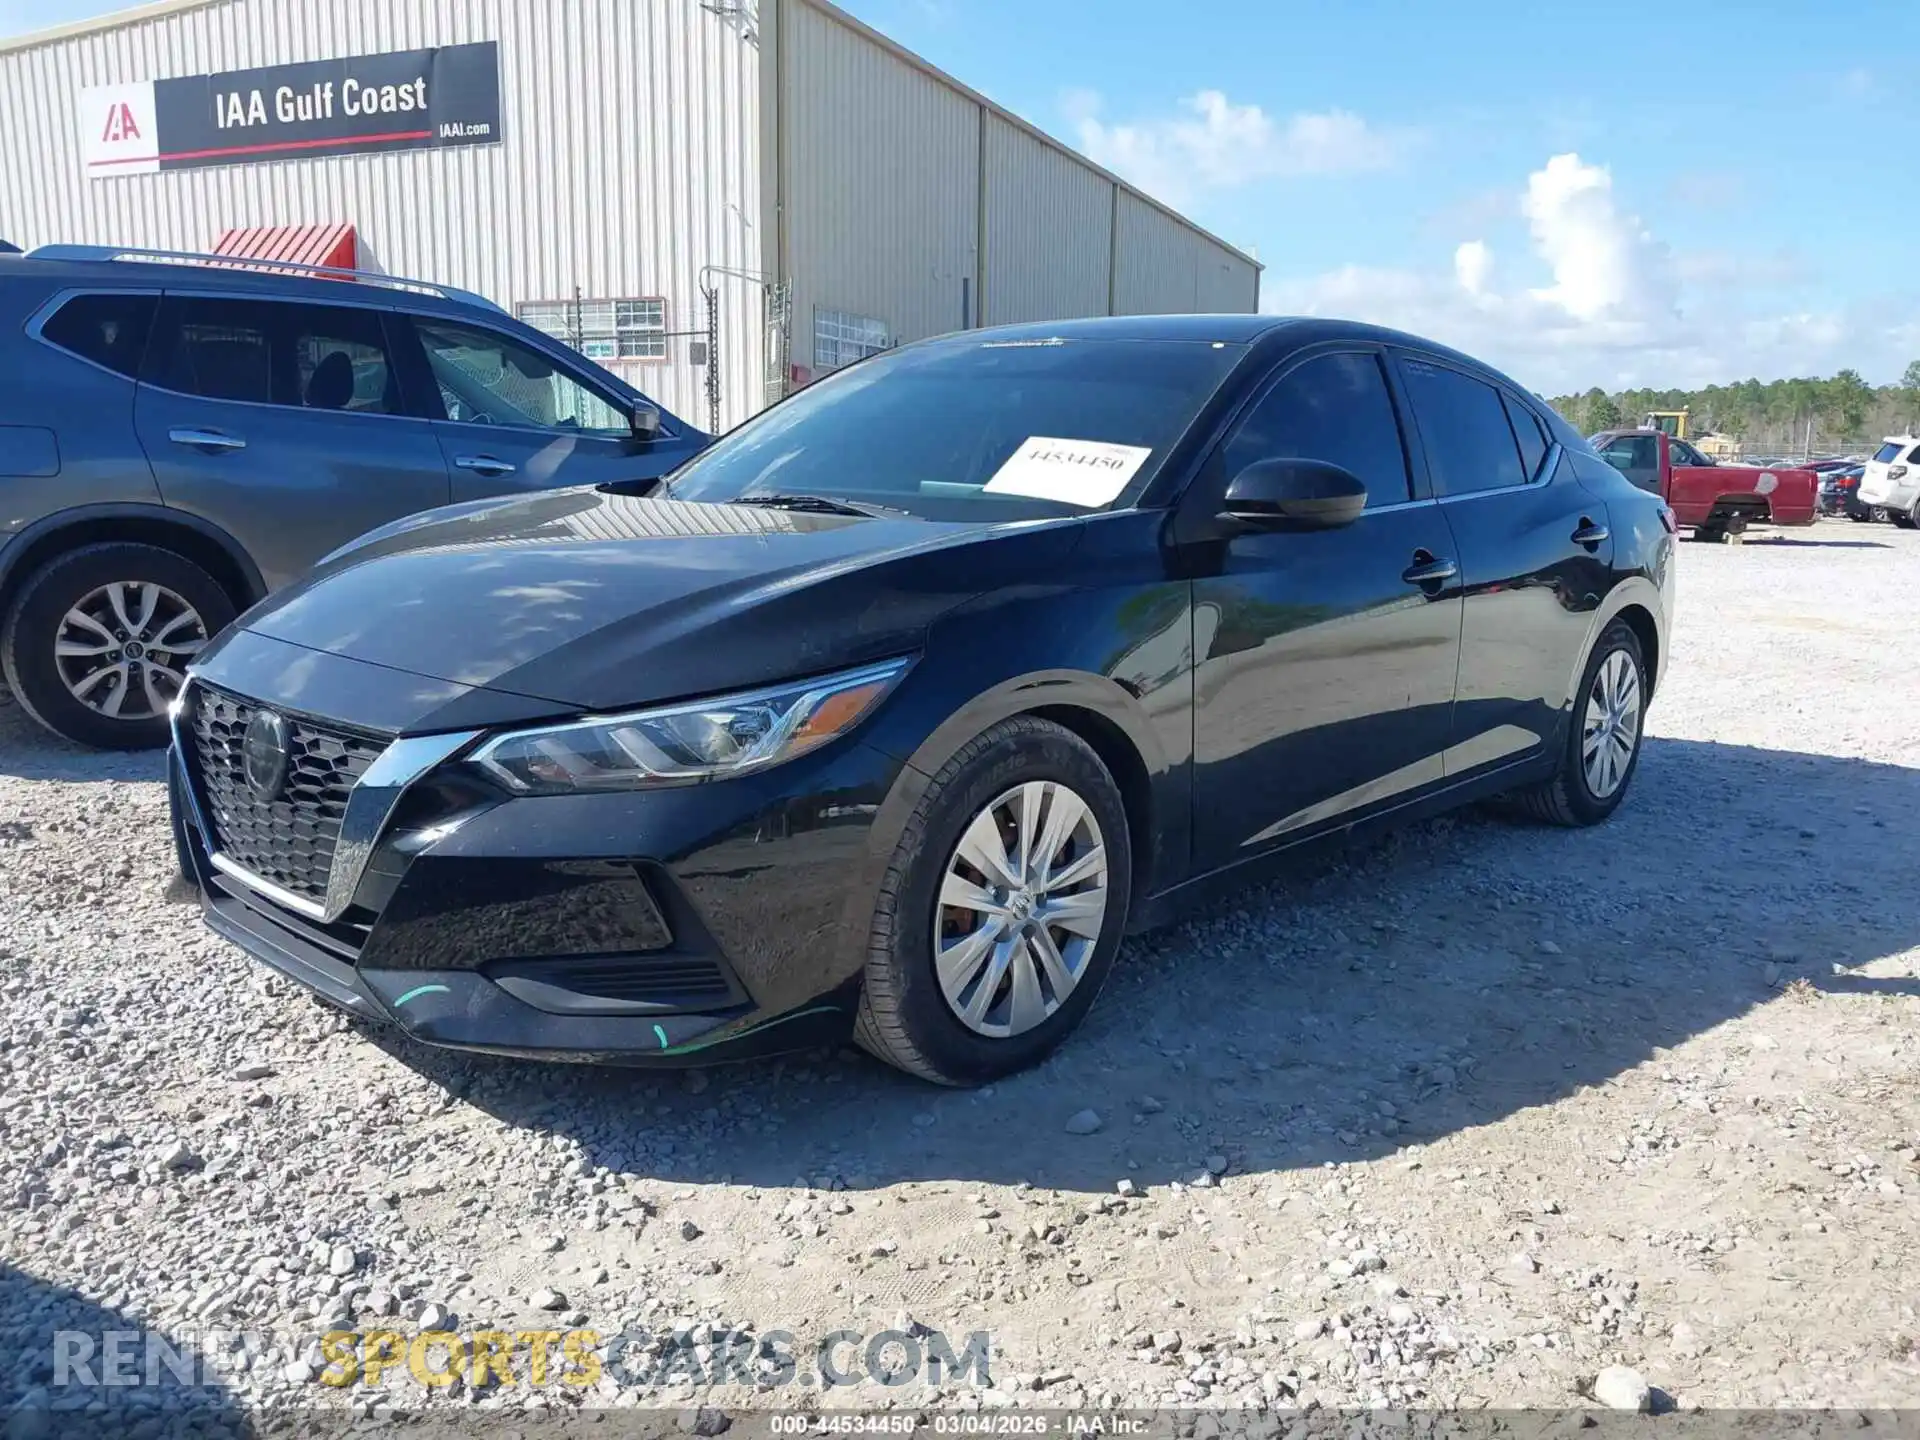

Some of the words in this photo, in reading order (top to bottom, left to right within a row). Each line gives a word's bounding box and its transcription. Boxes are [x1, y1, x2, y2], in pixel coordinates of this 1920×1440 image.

[217, 92, 268, 128] IAA
[275, 81, 334, 123] Gulf
[342, 76, 428, 116] Coast
[439, 121, 491, 138] IAAI.com
[1027, 450, 1125, 471] 44534450
